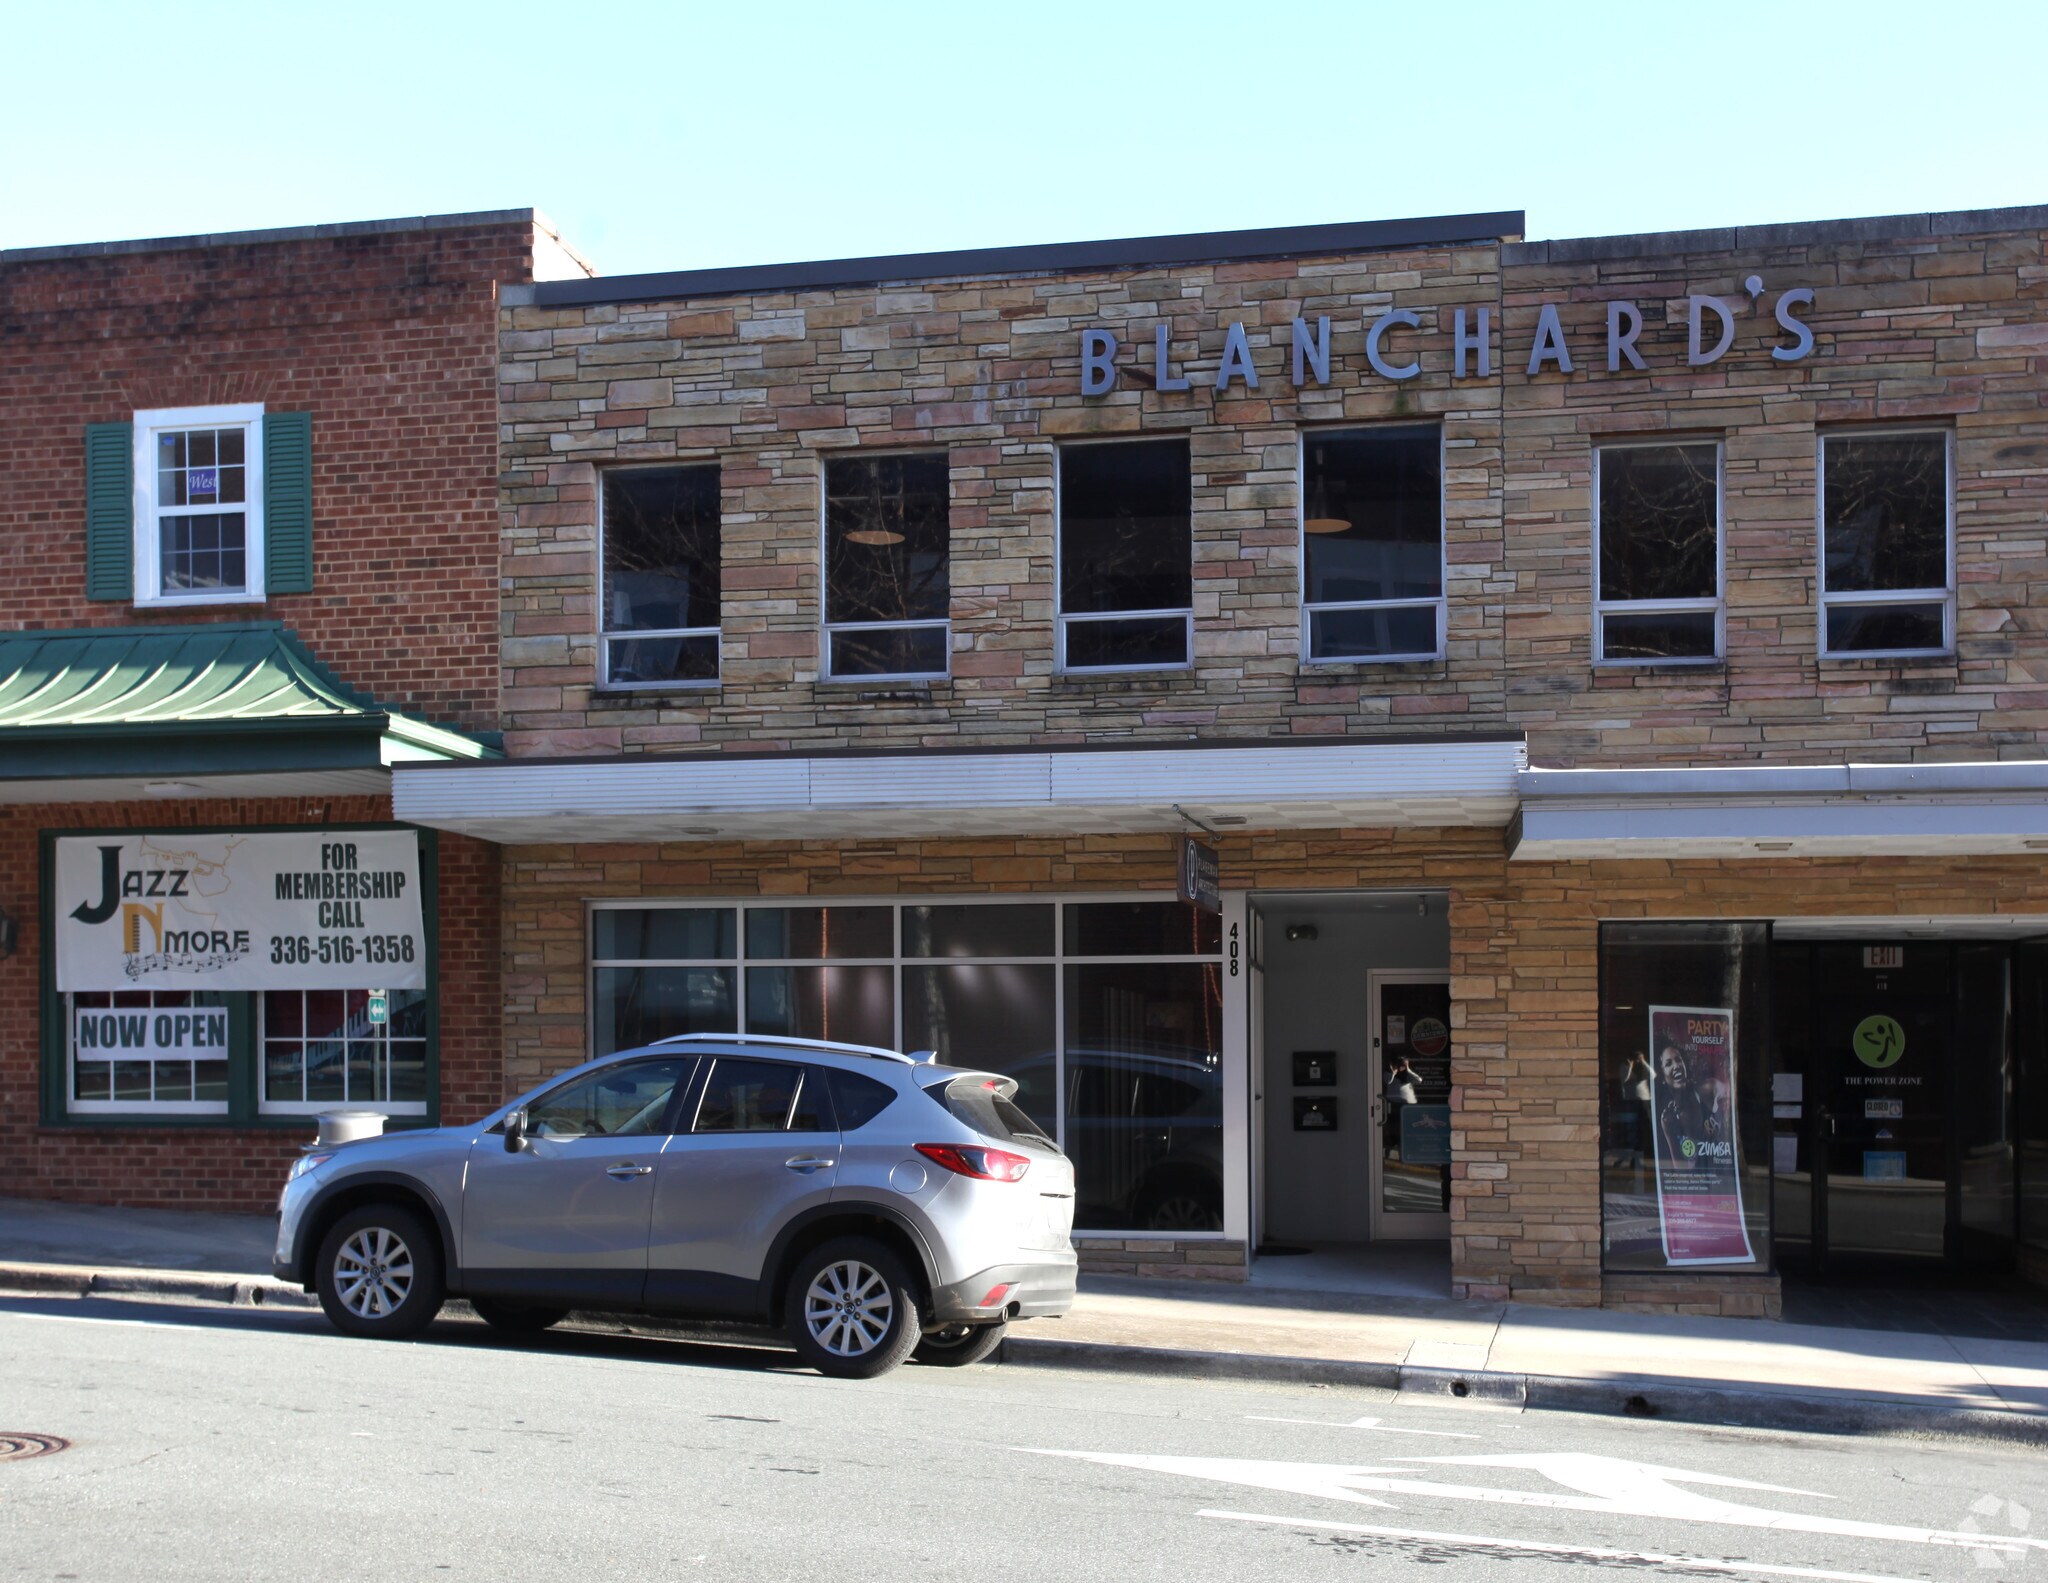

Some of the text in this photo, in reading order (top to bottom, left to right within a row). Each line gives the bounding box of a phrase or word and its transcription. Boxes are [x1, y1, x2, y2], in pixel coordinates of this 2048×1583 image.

[1081, 275, 1815, 396] BLANCHARD'S
[321, 843, 357, 870] FOR
[275, 871, 406, 900] MEMBERSHIP
[318, 901, 364, 928] CALL
[164, 930, 249, 953] MORE
[271, 935, 414, 965] 336-516-1358
[1229, 922, 1239, 976] 408
[1871, 946, 1895, 966] EXIT
[80, 1014, 226, 1048] NOW OPEN
[1687, 1019, 1727, 1035] PARTY
[1685, 1043, 1697, 1051] INTO
[1691, 1036, 1724, 1044] YOURSELF
[1845, 1077, 1923, 1085] THE POWER ZONE
[1697, 1141, 1731, 1157] ZUMBA
